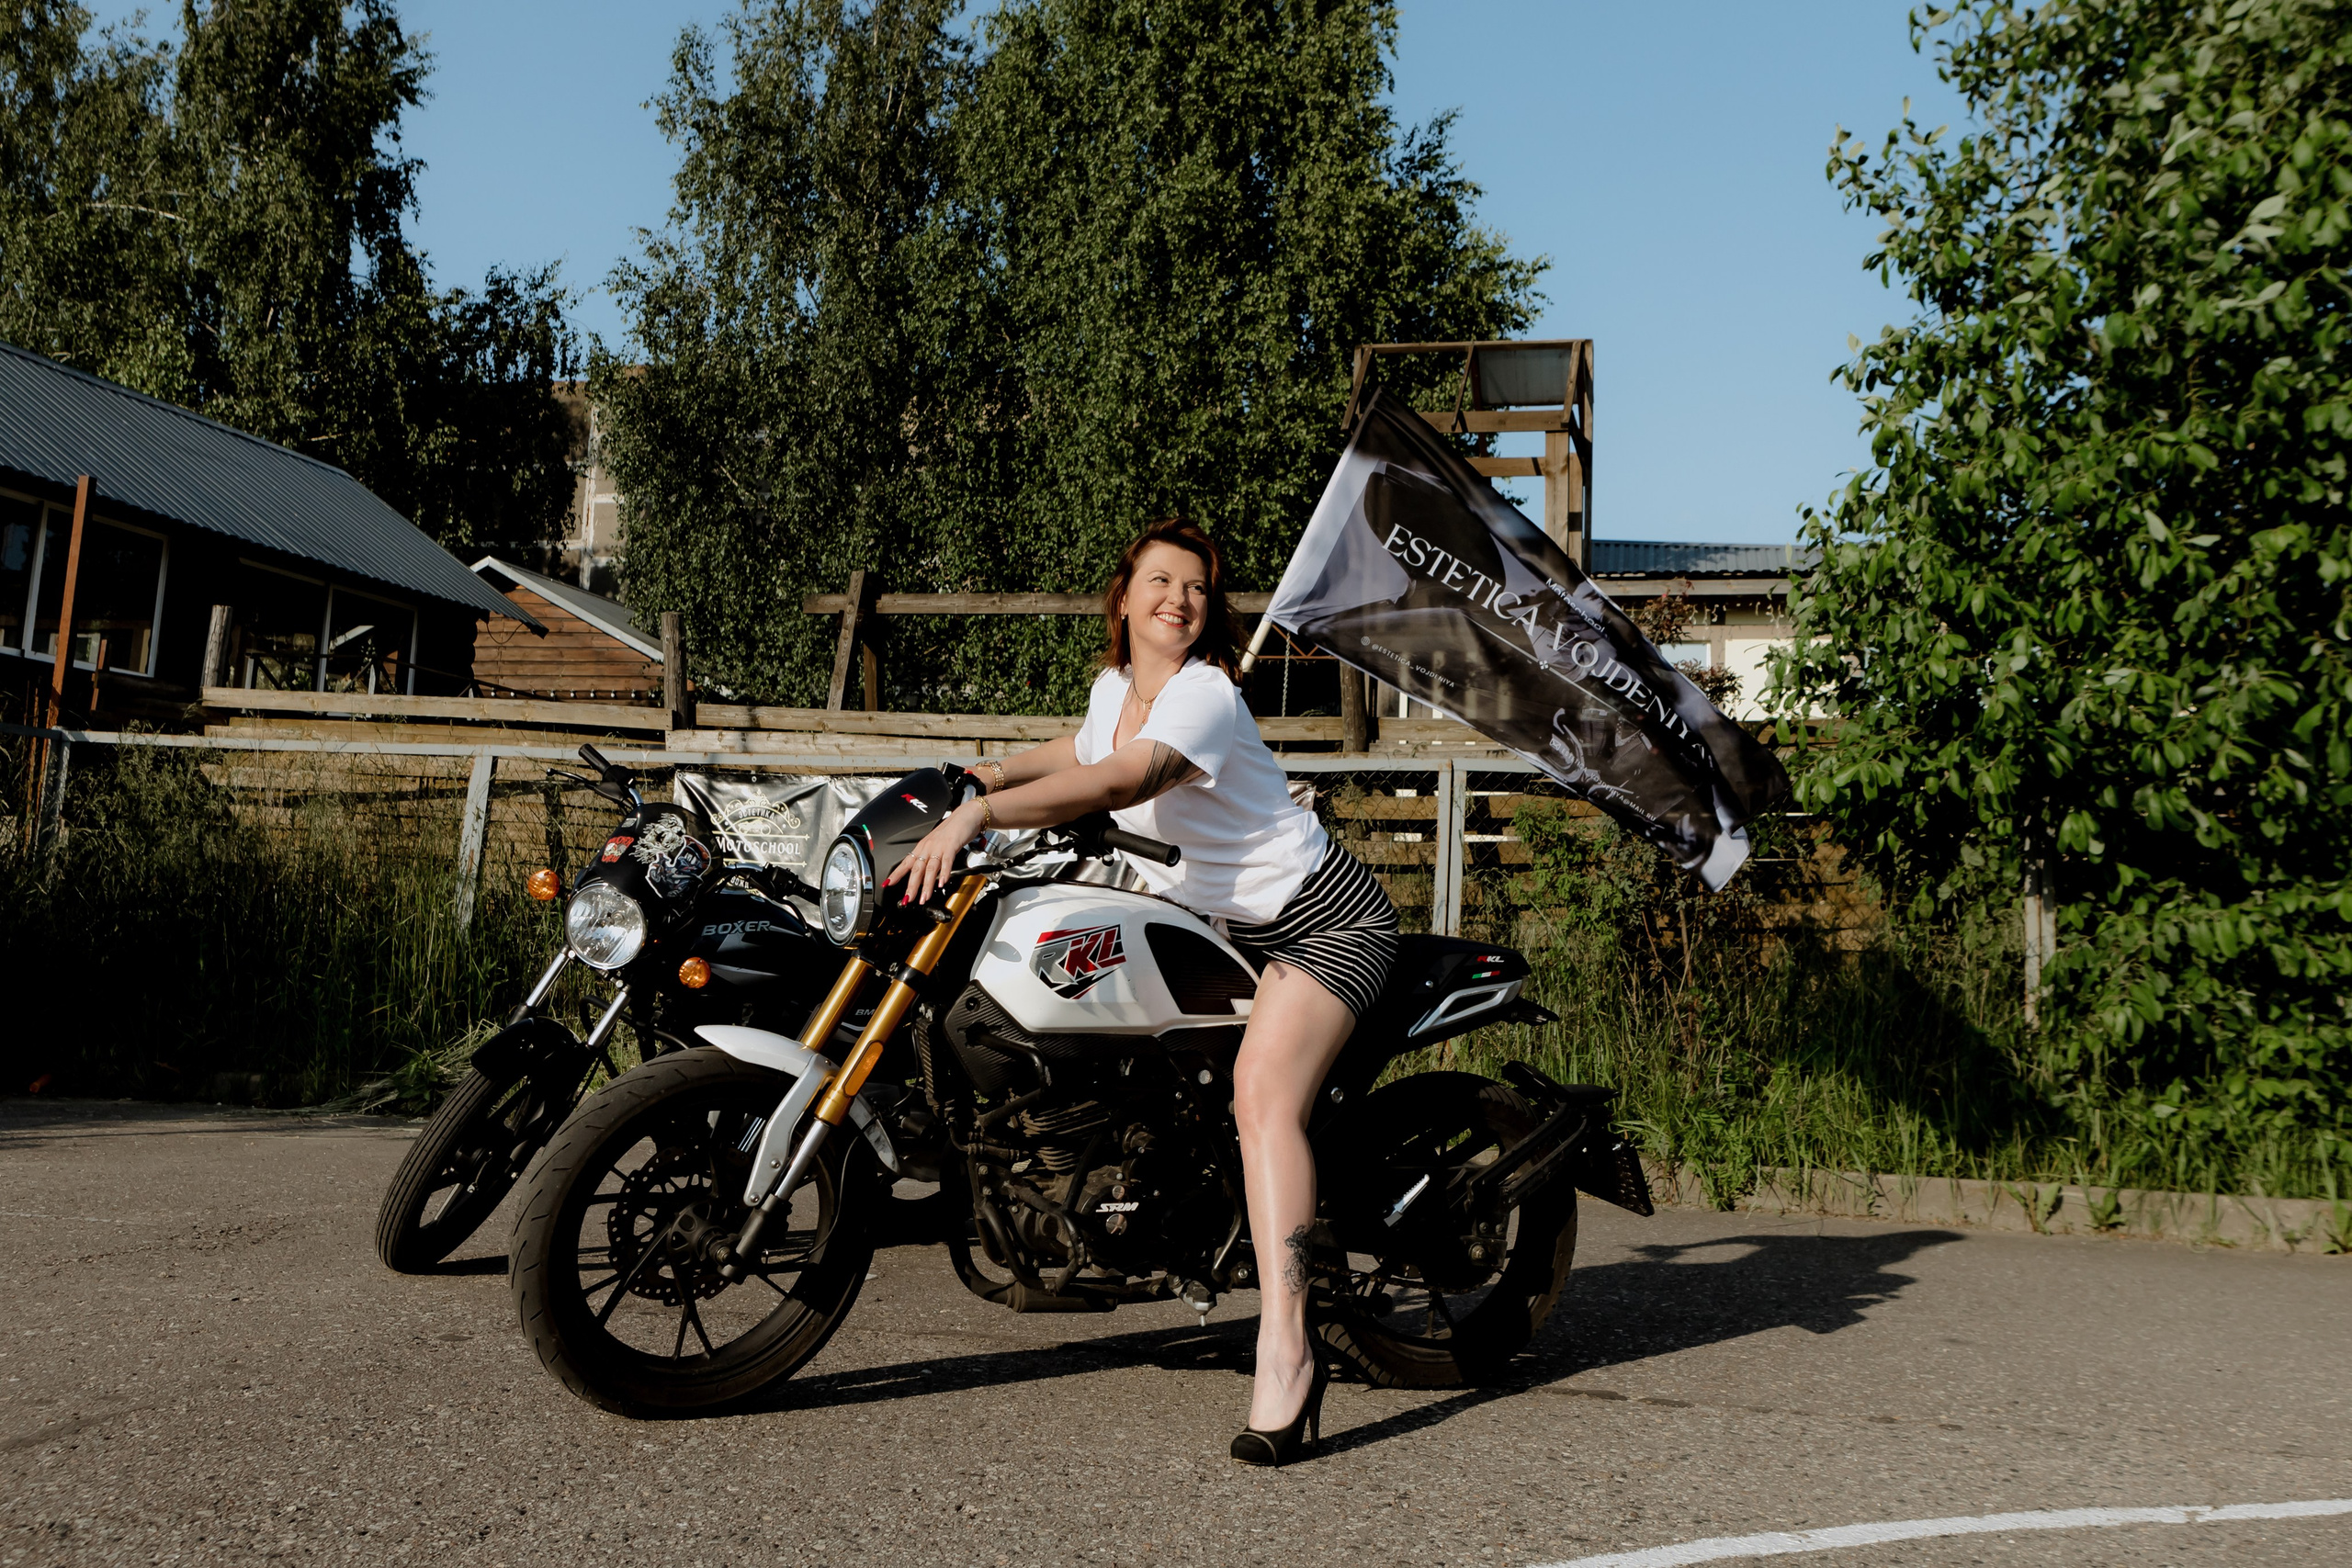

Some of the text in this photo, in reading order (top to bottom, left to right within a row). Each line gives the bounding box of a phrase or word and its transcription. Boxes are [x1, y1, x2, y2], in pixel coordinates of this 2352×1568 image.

[1382, 523, 1539, 637] ESTETICA
[900, 794, 928, 813] RKL
[738, 808, 775, 820] ЭСТЕТИКА
[715, 836, 801, 855] MOTOSCHOOL
[701, 920, 770, 936] BOXER
[1029, 928, 1126, 983] RKL
[1095, 1201, 1139, 1213] SRM
